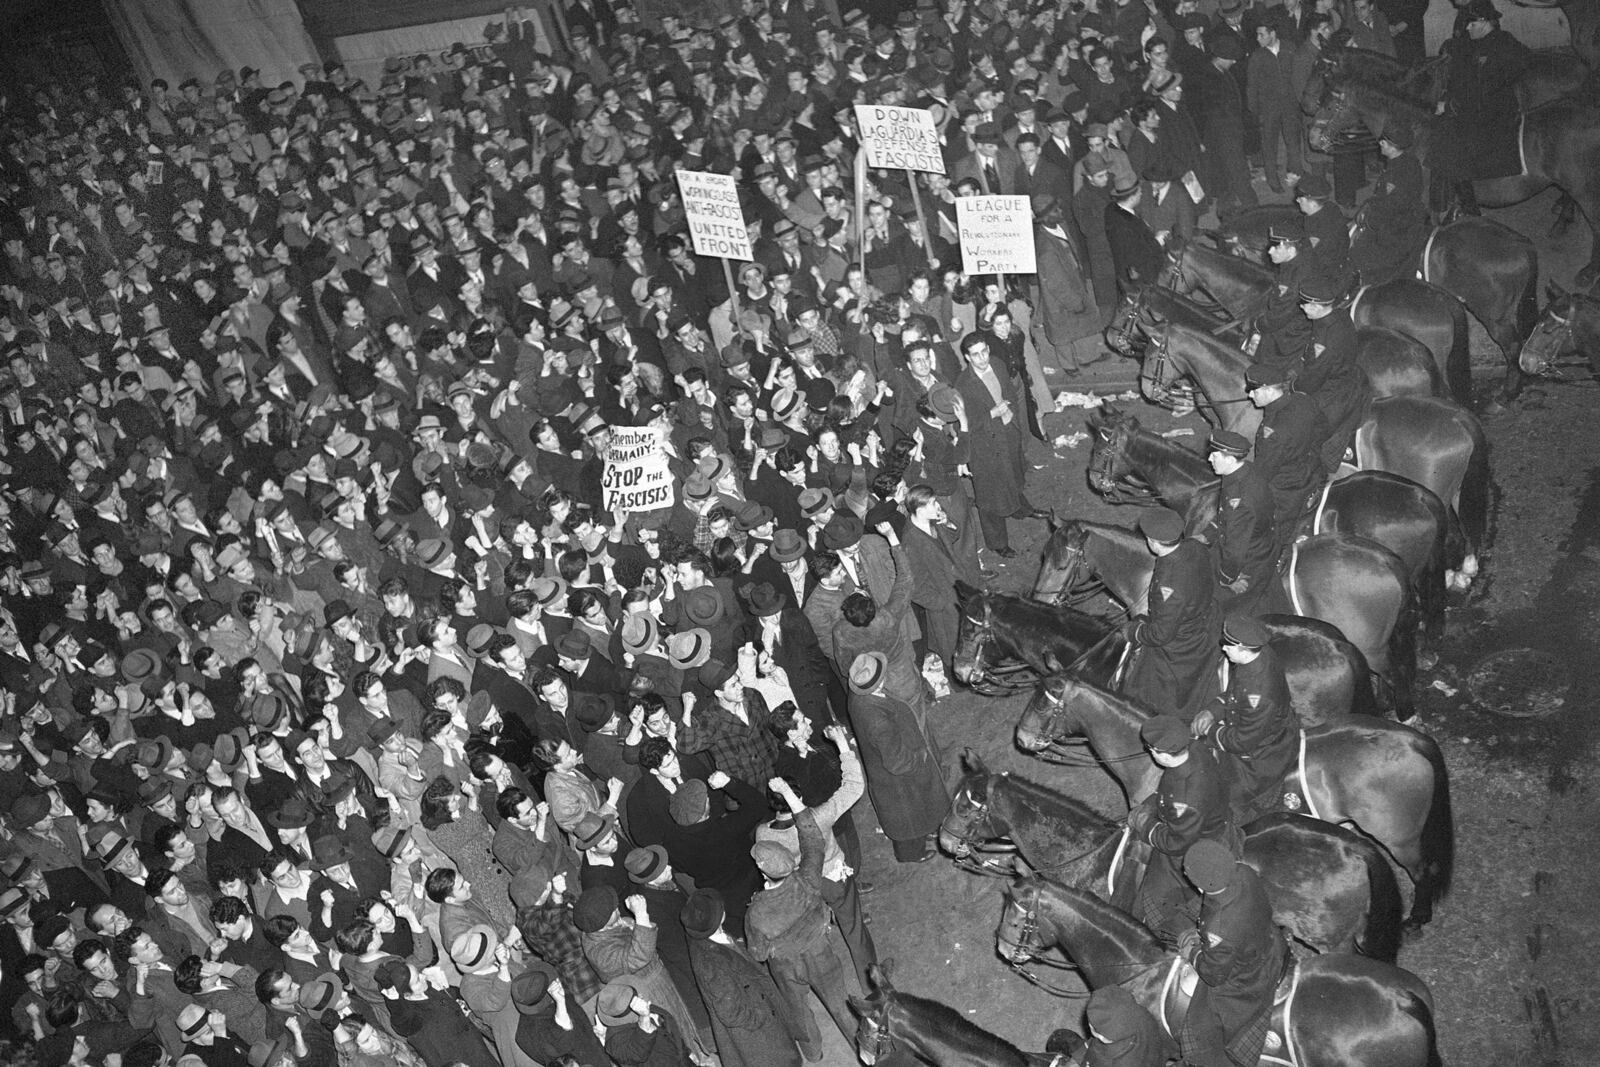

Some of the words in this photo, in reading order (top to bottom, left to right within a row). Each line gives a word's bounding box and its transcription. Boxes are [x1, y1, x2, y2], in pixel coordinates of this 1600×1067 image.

[875, 109, 920, 123] DOWN
[874, 138, 928, 153] DEFENSE
[875, 151, 944, 172] FASCISTS
[966, 199, 1022, 212] LEAGUE
[981, 214, 999, 223] FOR
[1005, 214, 1013, 223] A
[693, 222, 746, 239] UNITED
[700, 237, 747, 256] FRONT
[977, 260, 1017, 272] PARTY
[603, 464, 643, 488] STOP
[647, 471, 663, 482] THE
[606, 485, 668, 512] FASCISTS
